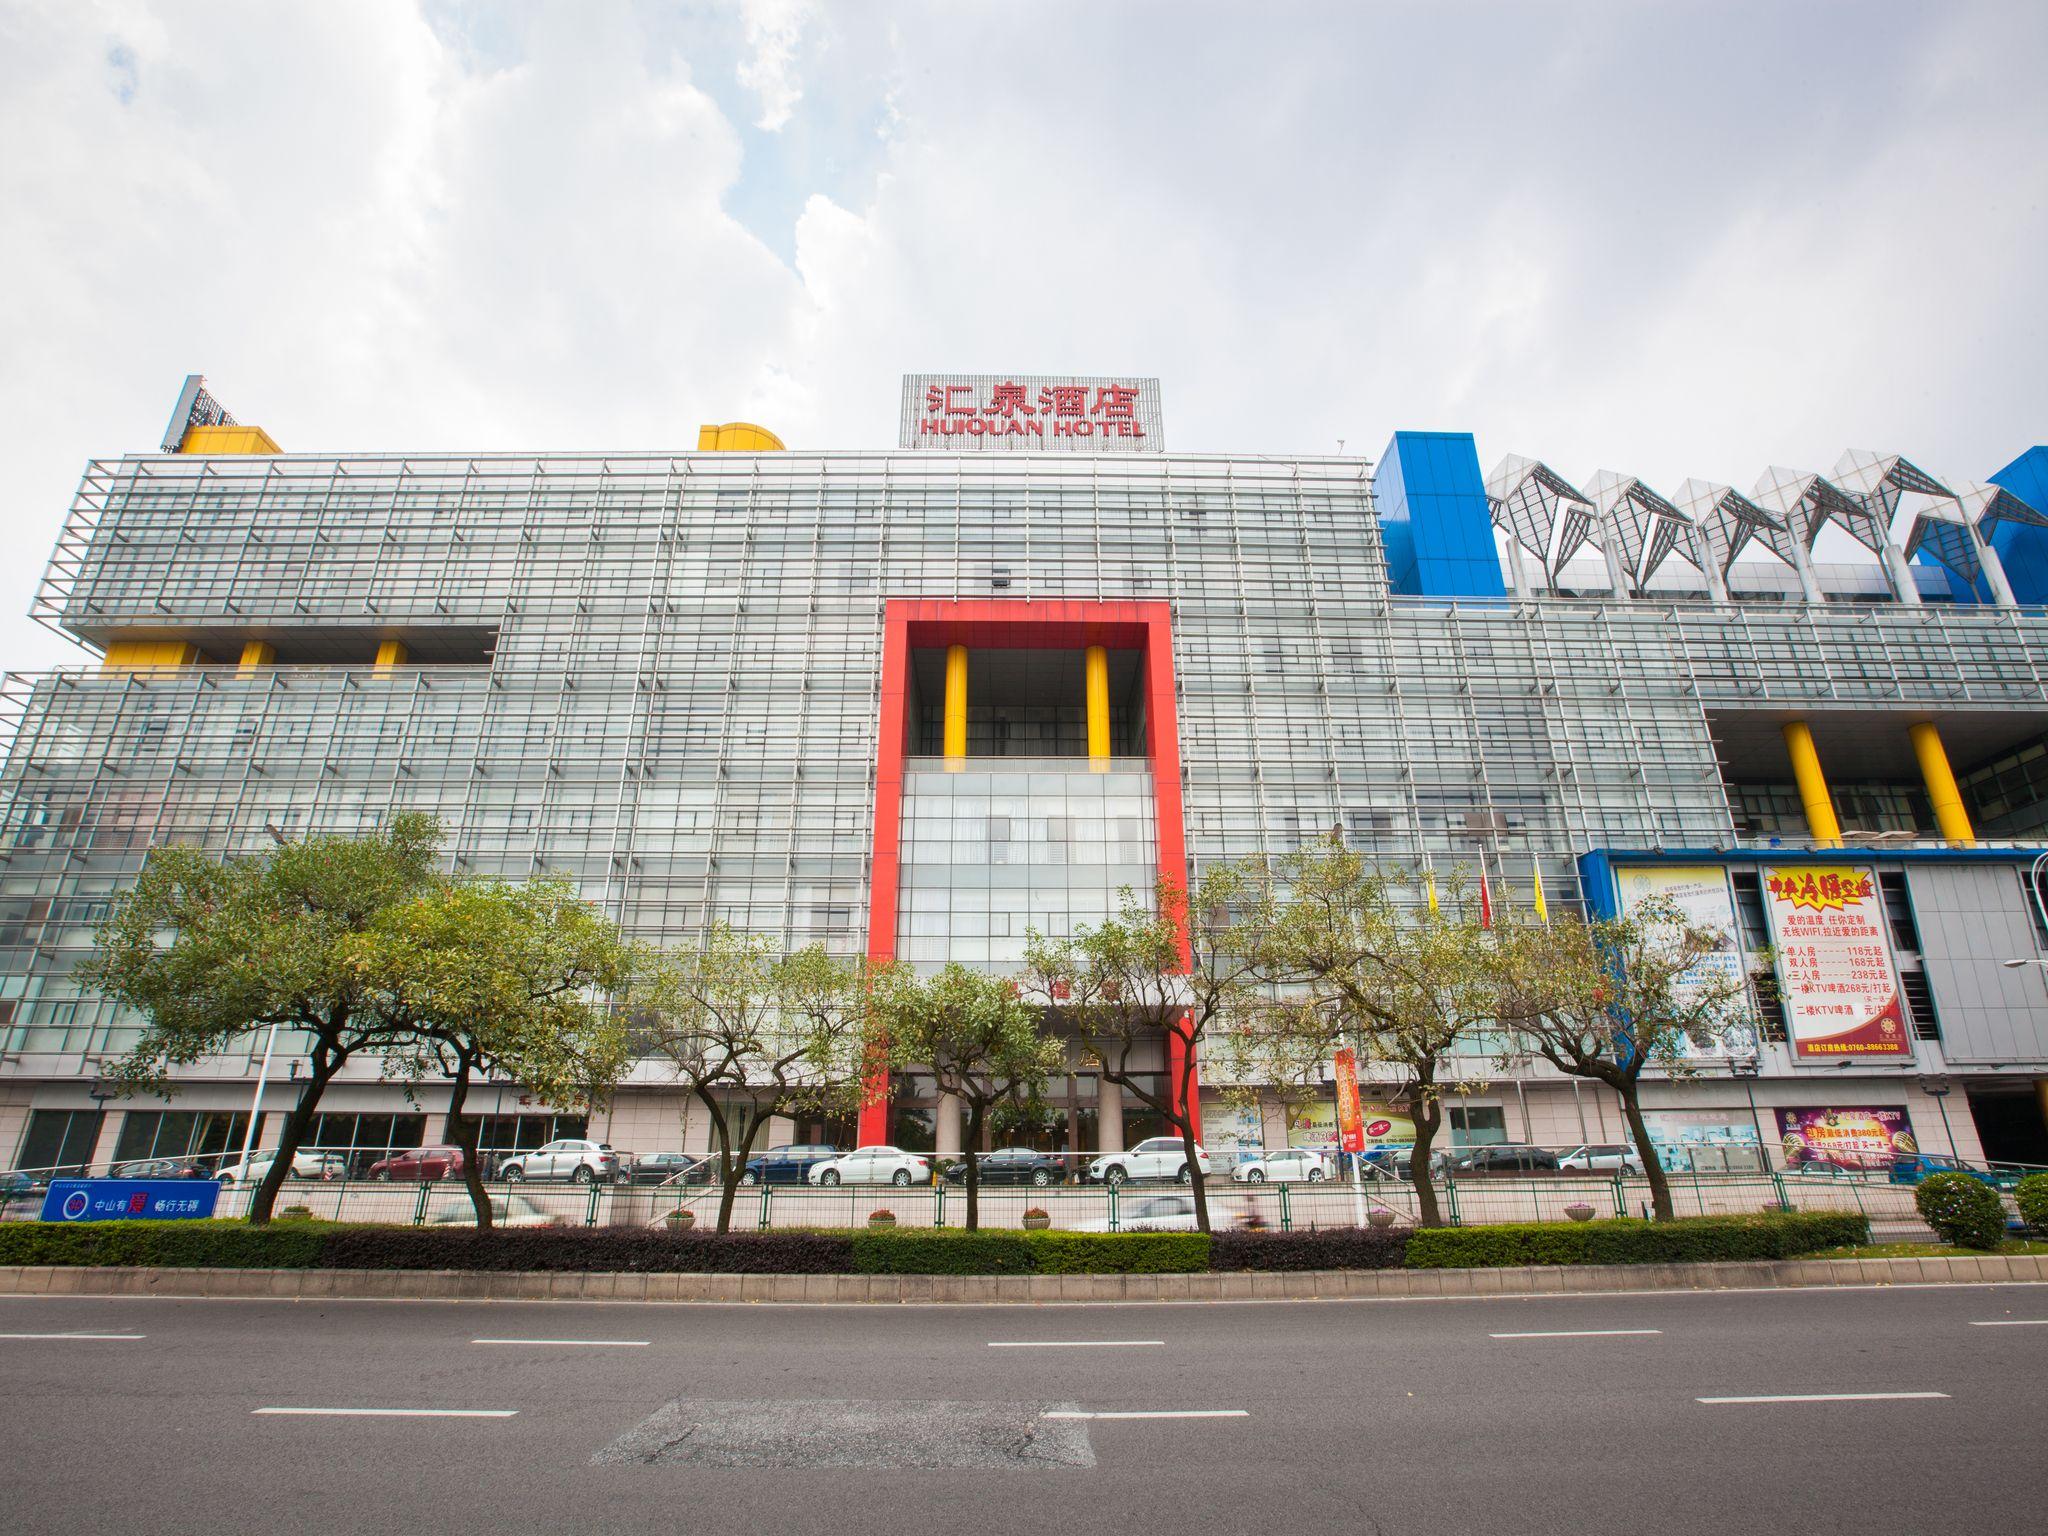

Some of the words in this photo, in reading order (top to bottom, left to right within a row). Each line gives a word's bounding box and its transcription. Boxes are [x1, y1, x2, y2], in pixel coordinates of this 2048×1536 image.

[926, 380, 1139, 417] 汇泉酒店
[1054, 420, 1146, 437] HOTEL
[1787, 915, 1824, 925] 爱的温度
[1829, 915, 1866, 925] 任你定制
[154, 1199, 200, 1212] 畅行无碍
